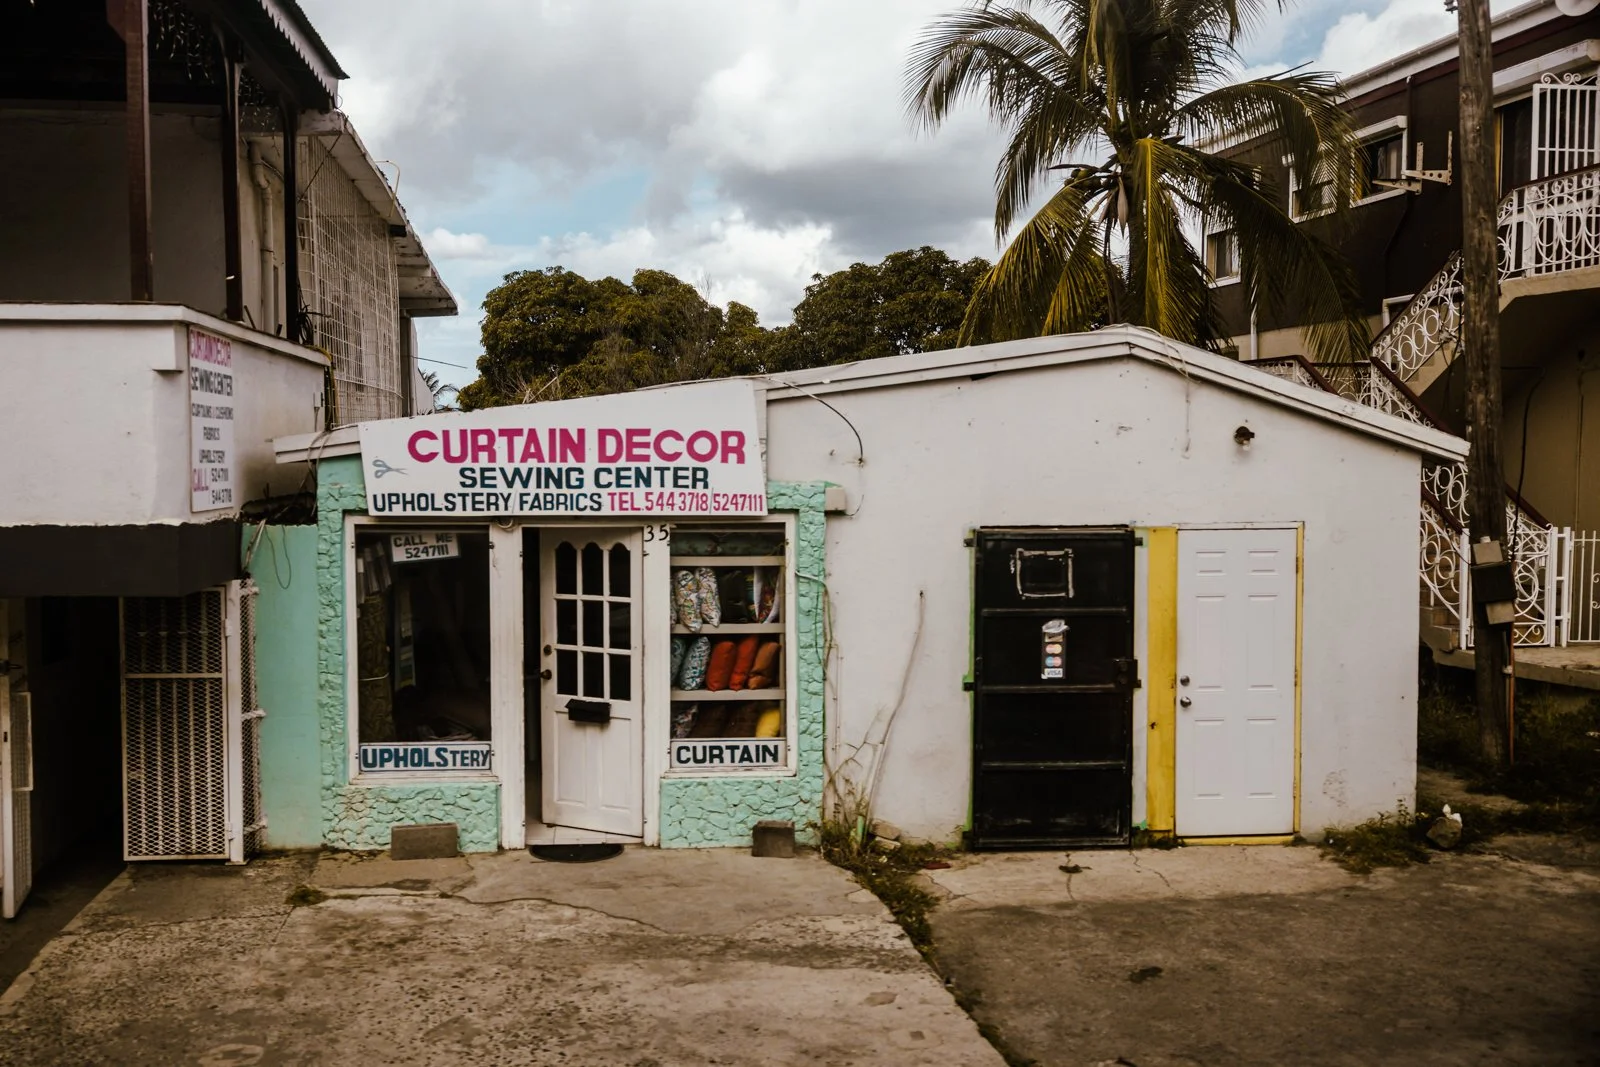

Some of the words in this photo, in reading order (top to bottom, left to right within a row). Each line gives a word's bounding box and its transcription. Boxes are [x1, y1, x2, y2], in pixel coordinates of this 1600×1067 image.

[191, 366, 213, 393] SEWING
[214, 371, 233, 396] CENTER
[407, 428, 586, 464] CURTAIN
[597, 428, 746, 464] DECOR
[192, 468, 209, 492] CALL
[459, 466, 585, 489] SEWING
[594, 466, 709, 489] CENTER
[393, 535, 428, 548] CALL
[435, 533, 453, 544] ME
[644, 524, 669, 542] 35
[405, 544, 449, 559] 5247111
[362, 747, 490, 769] UPHOLSTERY
[676, 744, 779, 764] CURTAIN
